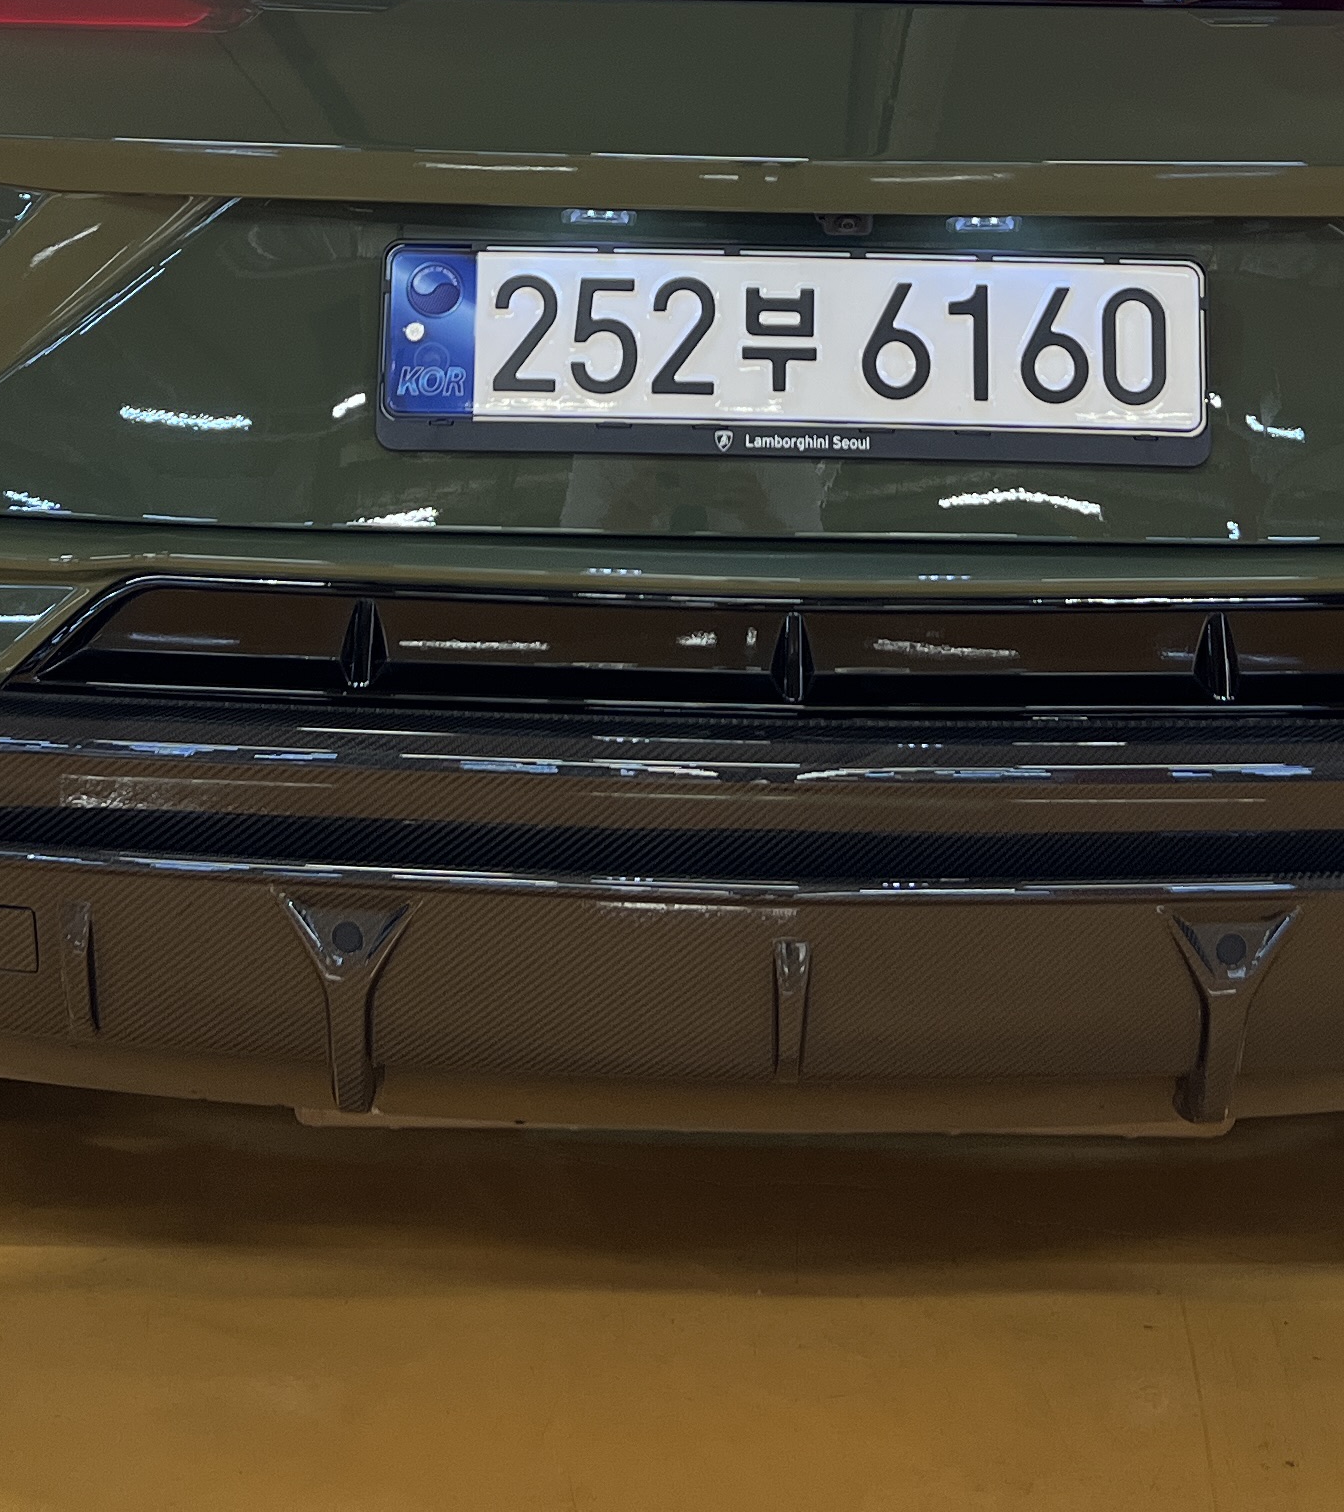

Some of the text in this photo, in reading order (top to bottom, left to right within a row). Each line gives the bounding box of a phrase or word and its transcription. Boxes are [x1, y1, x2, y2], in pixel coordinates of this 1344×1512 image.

[396, 365, 467, 397] KOR
[745, 433, 871, 452] Lamborghini Seoul
